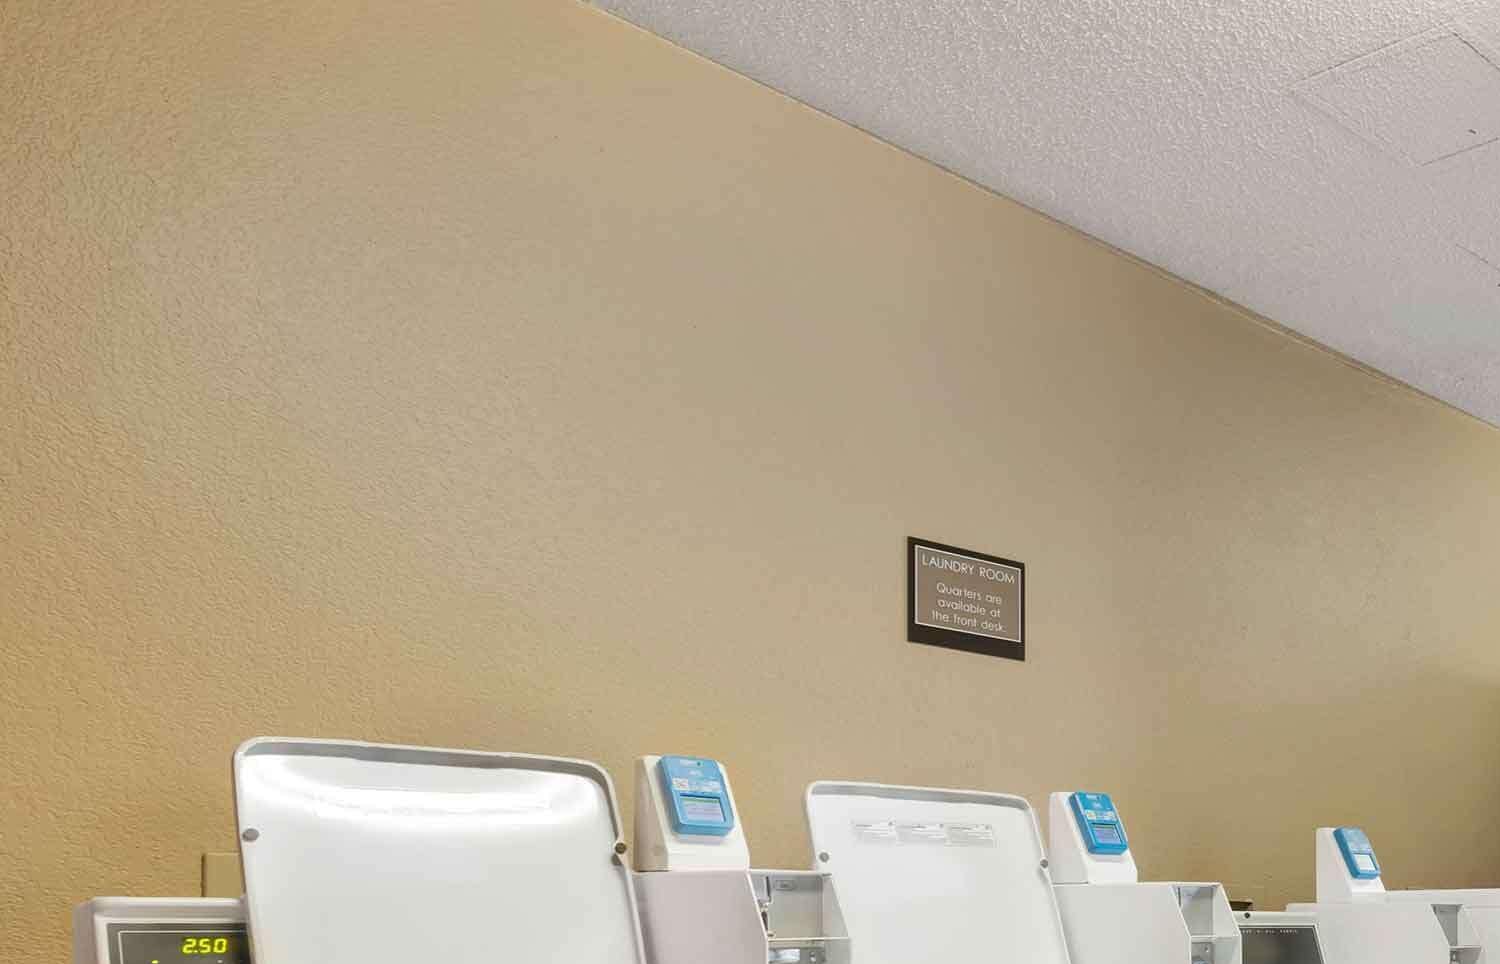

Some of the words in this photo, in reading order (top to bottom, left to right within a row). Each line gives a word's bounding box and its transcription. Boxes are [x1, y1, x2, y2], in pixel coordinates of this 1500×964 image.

[921, 553, 974, 574] LAUNDRY
[979, 567, 1015, 583] ROOM
[936, 582, 981, 599] Quarters
[985, 595, 1002, 604] are
[937, 600, 986, 615] available
[990, 608, 1001, 618] at
[931, 610, 949, 622] the
[953, 614, 976, 627] front
[182, 938, 228, 953] 2.50
